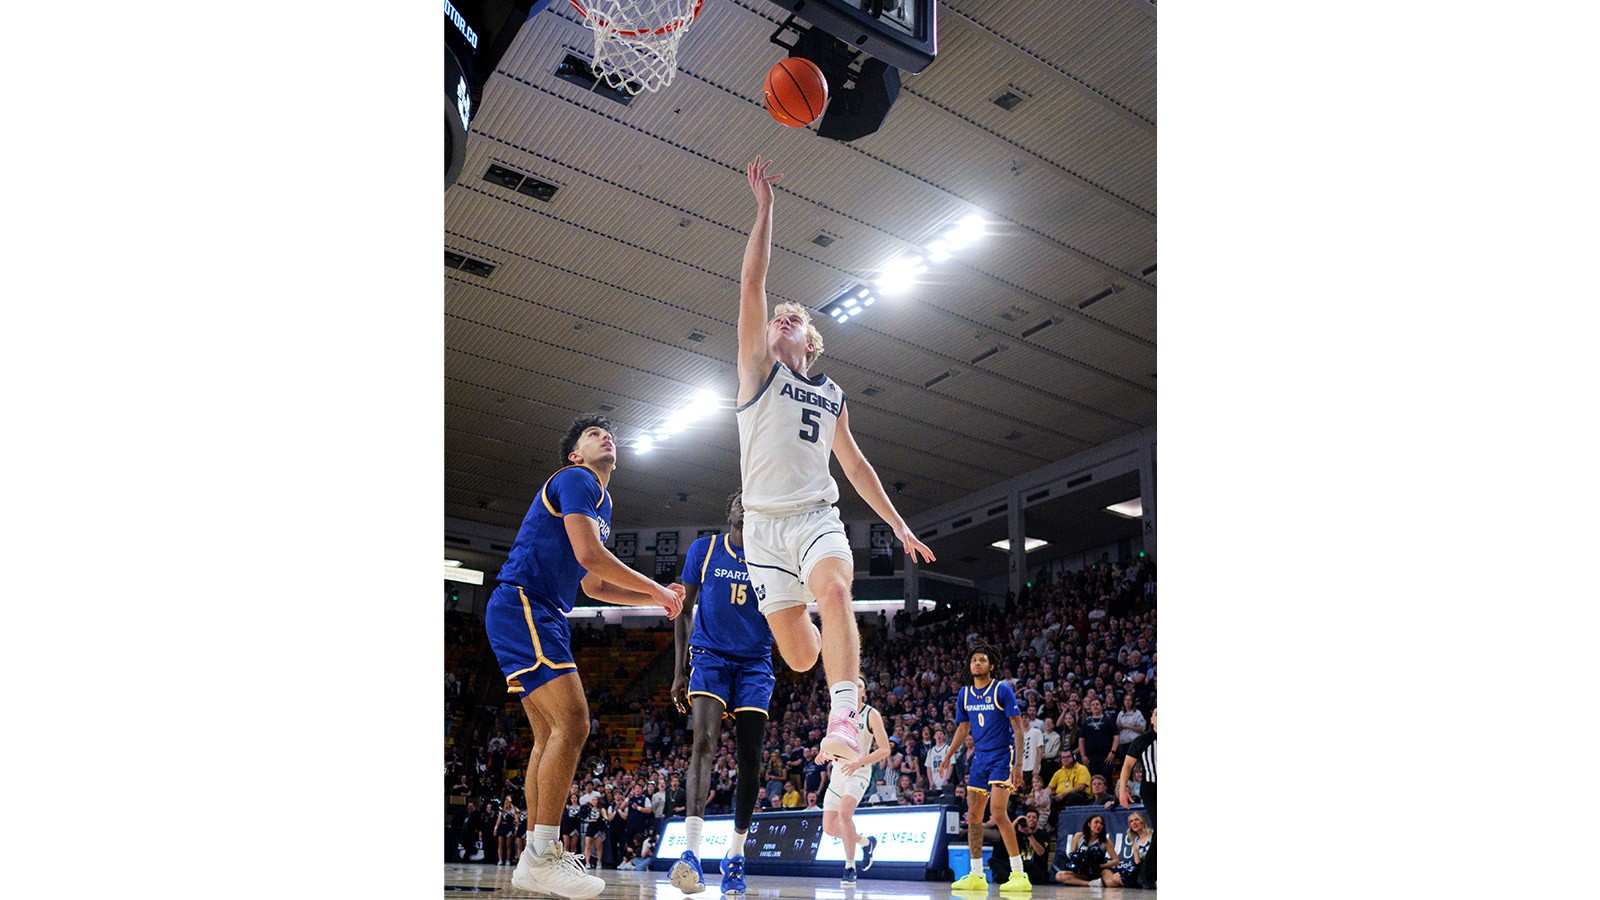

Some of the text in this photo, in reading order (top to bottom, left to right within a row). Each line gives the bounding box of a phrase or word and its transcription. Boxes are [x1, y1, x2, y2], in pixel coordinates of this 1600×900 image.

[780, 383, 840, 417] AGGIES
[799, 408, 821, 443] 5
[730, 582, 748, 606] 15
[977, 713, 985, 727] 0
[890, 832, 927, 843] MEALS
